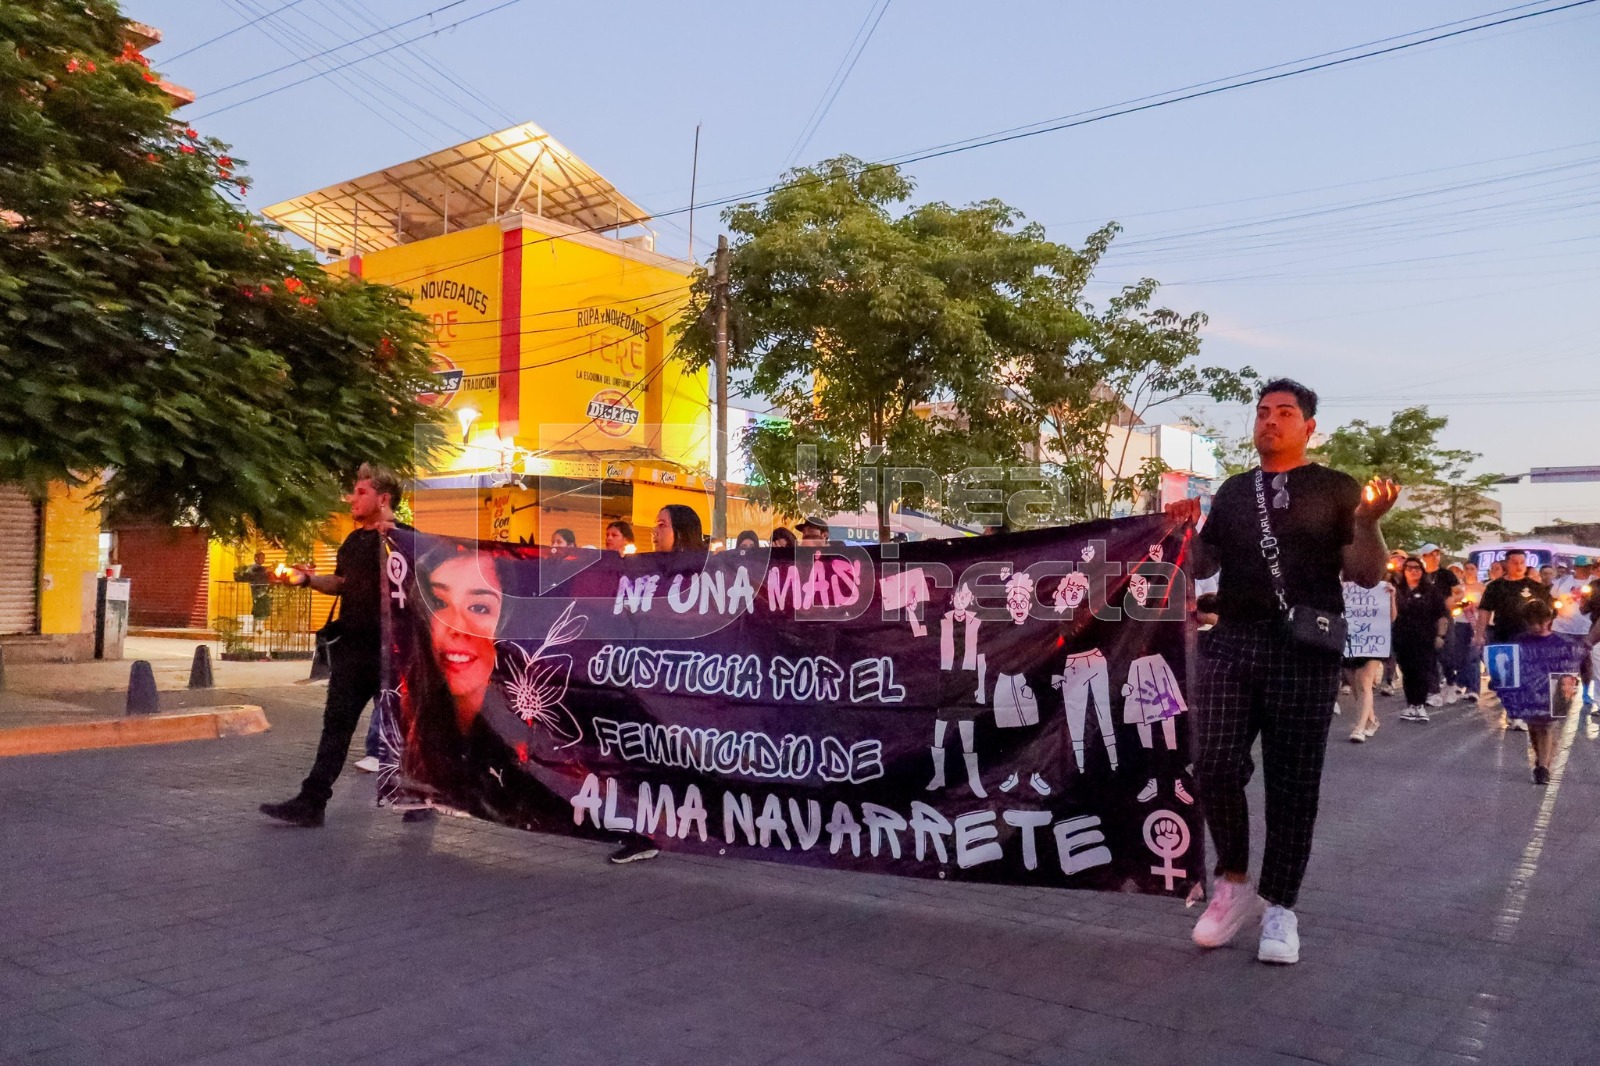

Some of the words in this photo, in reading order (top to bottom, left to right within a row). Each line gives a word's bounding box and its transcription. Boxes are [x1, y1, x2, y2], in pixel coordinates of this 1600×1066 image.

[421, 280, 488, 315] NOVEDADES
[578, 308, 600, 328] ROPA
[605, 308, 650, 342] NOVEDADES
[576, 369, 583, 379] LA
[587, 332, 642, 377] TERE
[588, 402, 638, 424] Dickies
[667, 565, 755, 615] UNA
[588, 644, 763, 698] JUSTICIA
[769, 655, 845, 701] POR
[849, 656, 906, 703] EL
[592, 716, 814, 780] FEMINICIDIO
[817, 736, 885, 784] DE
[570, 773, 709, 842] ALMA
[722, 789, 1113, 876] NAVARRETE
